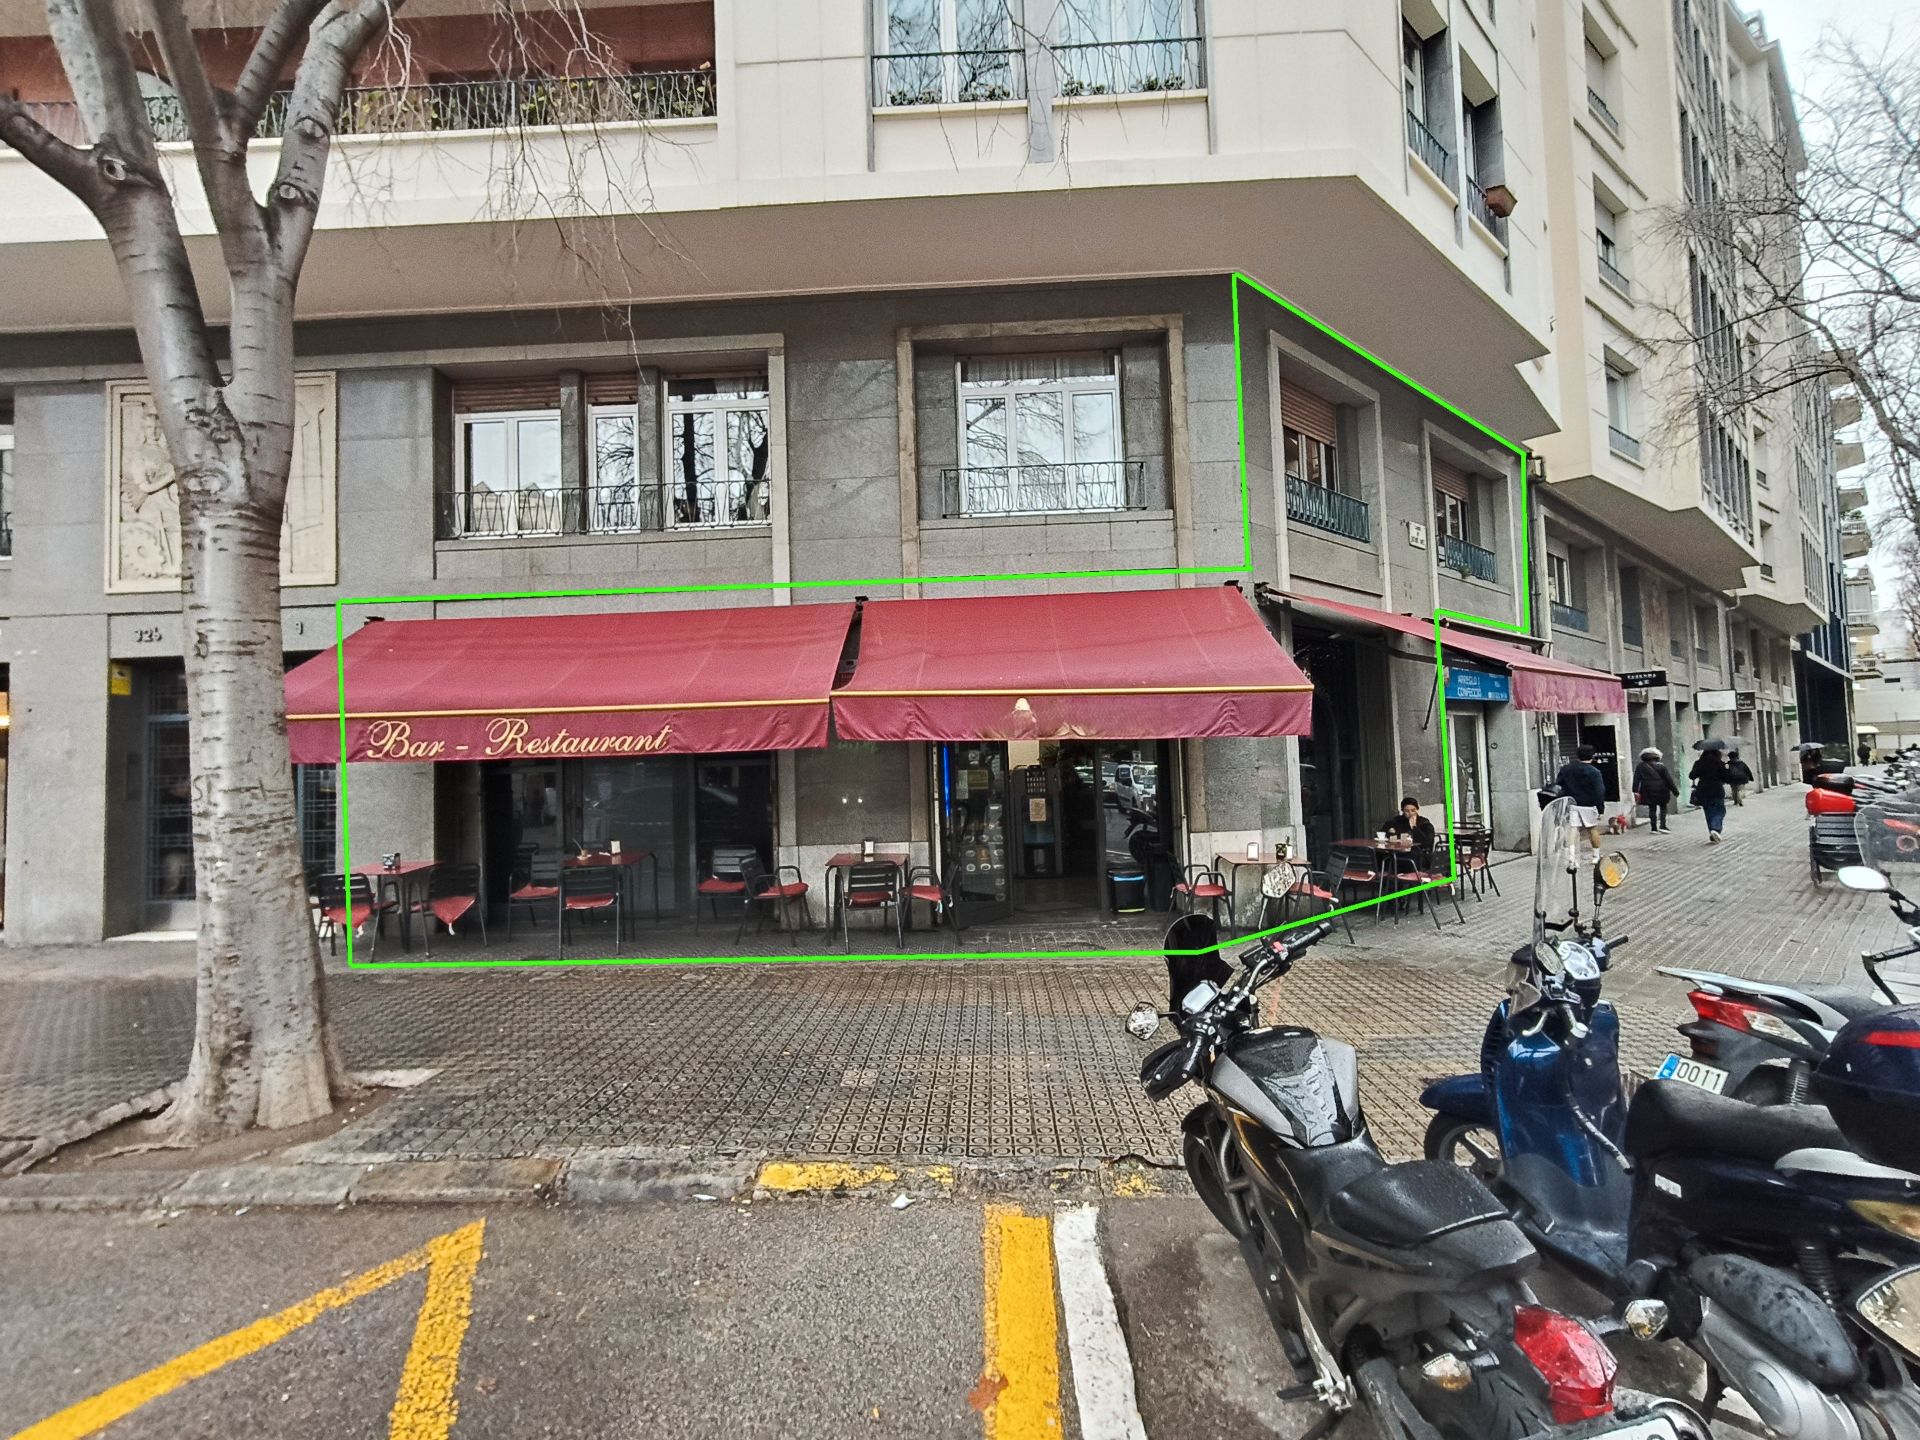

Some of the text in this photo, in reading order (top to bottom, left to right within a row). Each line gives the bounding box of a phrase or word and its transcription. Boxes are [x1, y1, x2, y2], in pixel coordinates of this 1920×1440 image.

[366, 720, 445, 759] Bar
[485, 717, 672, 756] Restaurant
[1677, 1062, 1721, 1091] 0011
